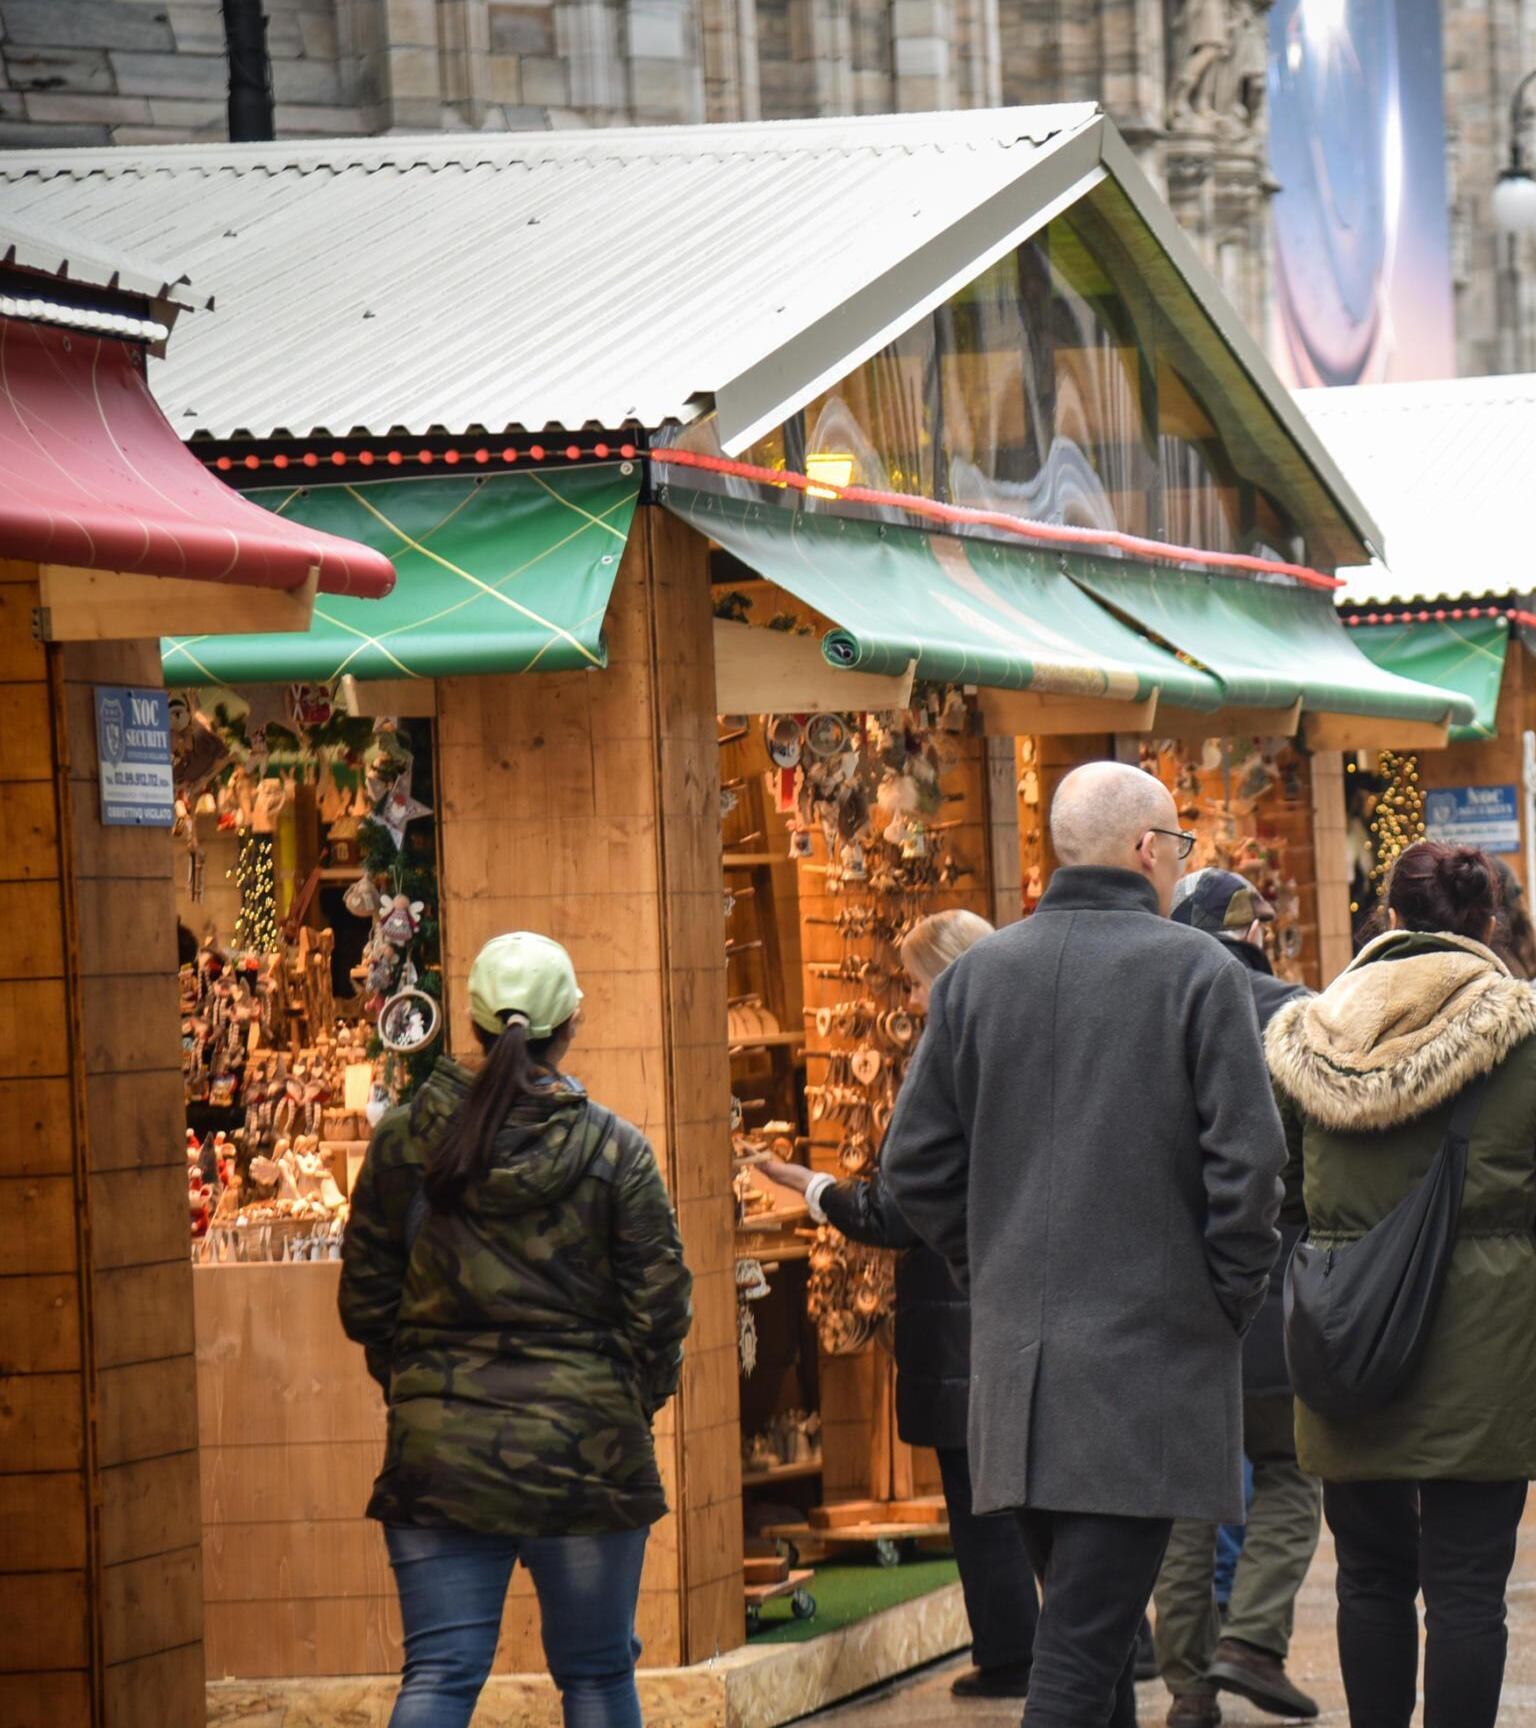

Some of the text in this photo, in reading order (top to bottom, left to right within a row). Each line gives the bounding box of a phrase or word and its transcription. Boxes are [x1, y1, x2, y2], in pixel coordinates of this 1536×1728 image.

[131, 698, 159, 726] NOC
[126, 729, 168, 749] SECURITY
[144, 808, 172, 820] VIGILATO
